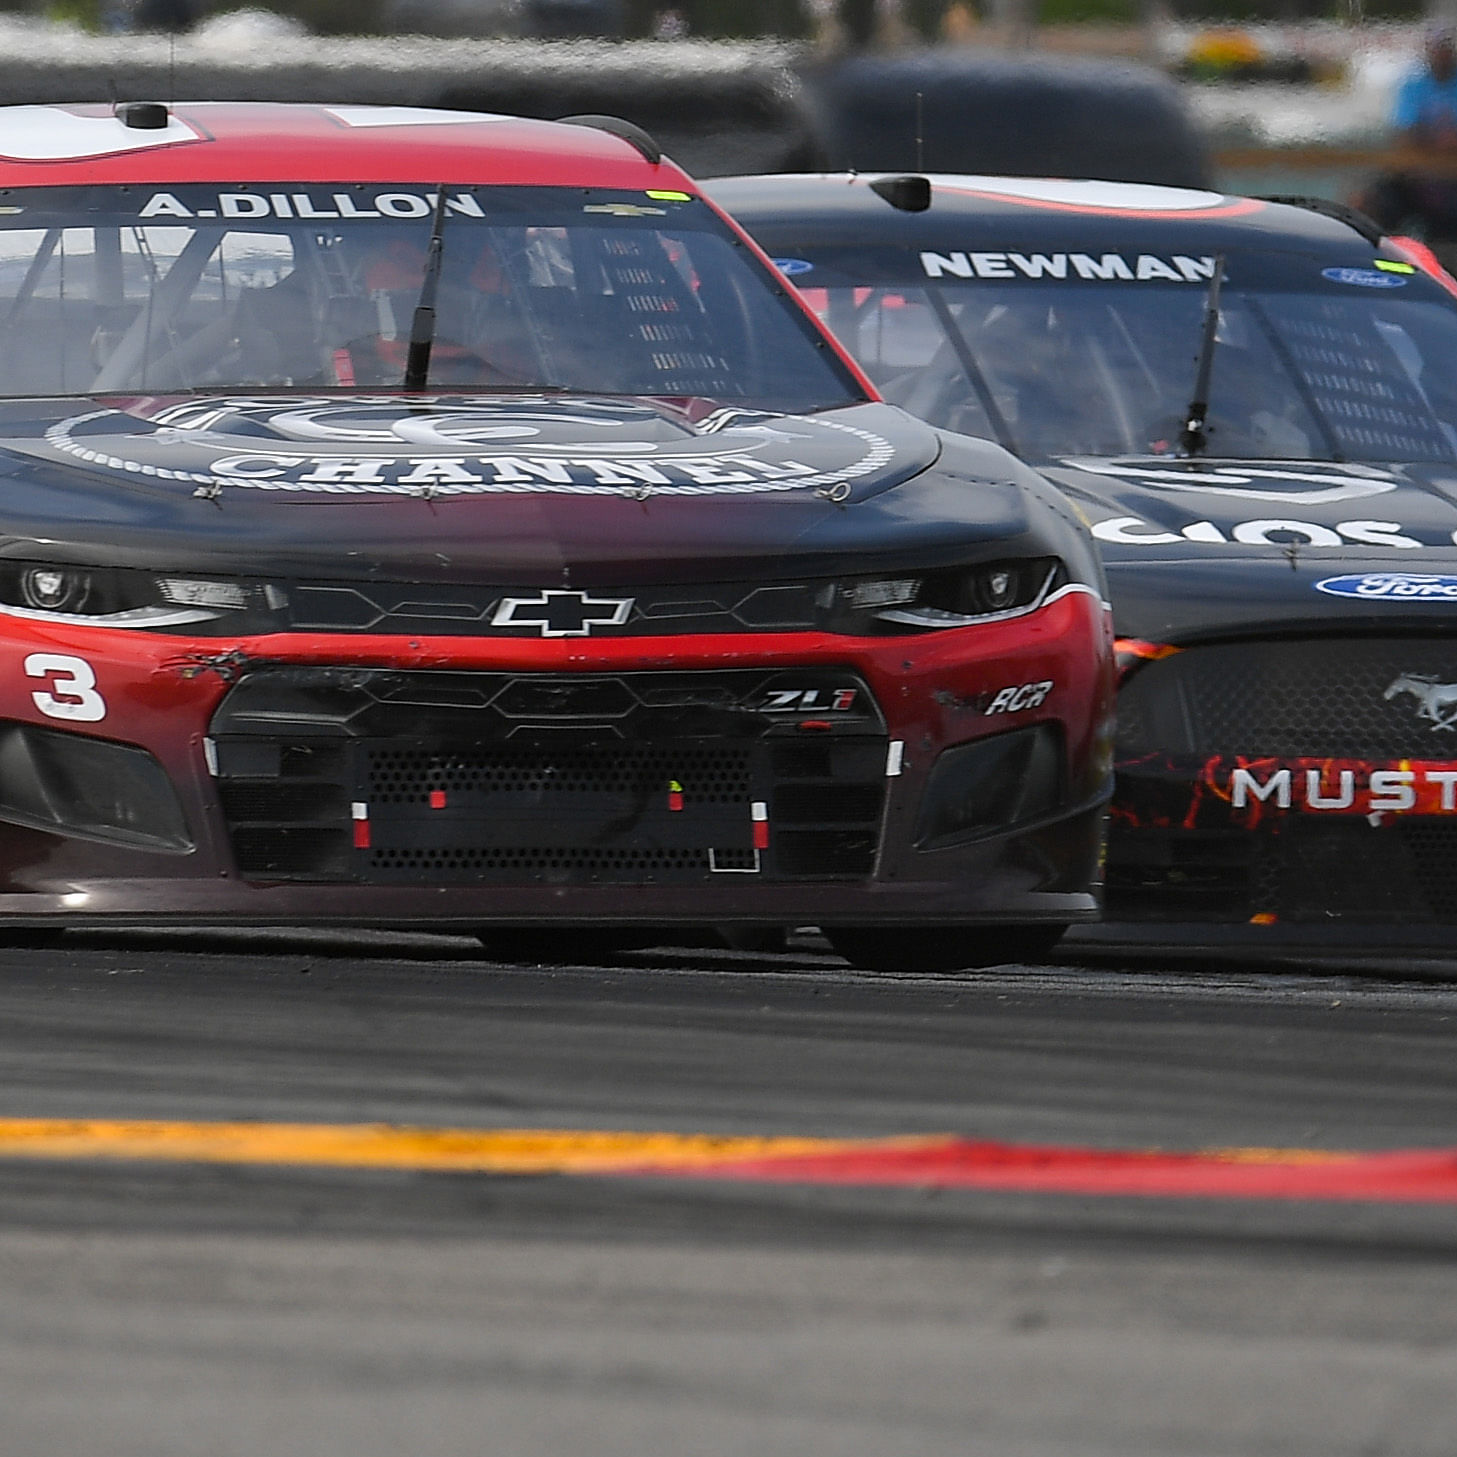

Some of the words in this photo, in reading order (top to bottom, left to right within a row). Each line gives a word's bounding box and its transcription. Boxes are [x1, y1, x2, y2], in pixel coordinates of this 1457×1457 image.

[138, 192, 487, 219] A.DILLON
[920, 250, 1229, 283] NEWMAN
[207, 452, 819, 486] CHANNEL
[24, 652, 107, 722] 3
[758, 688, 857, 712] ZL1
[984, 680, 1054, 716] RCR
